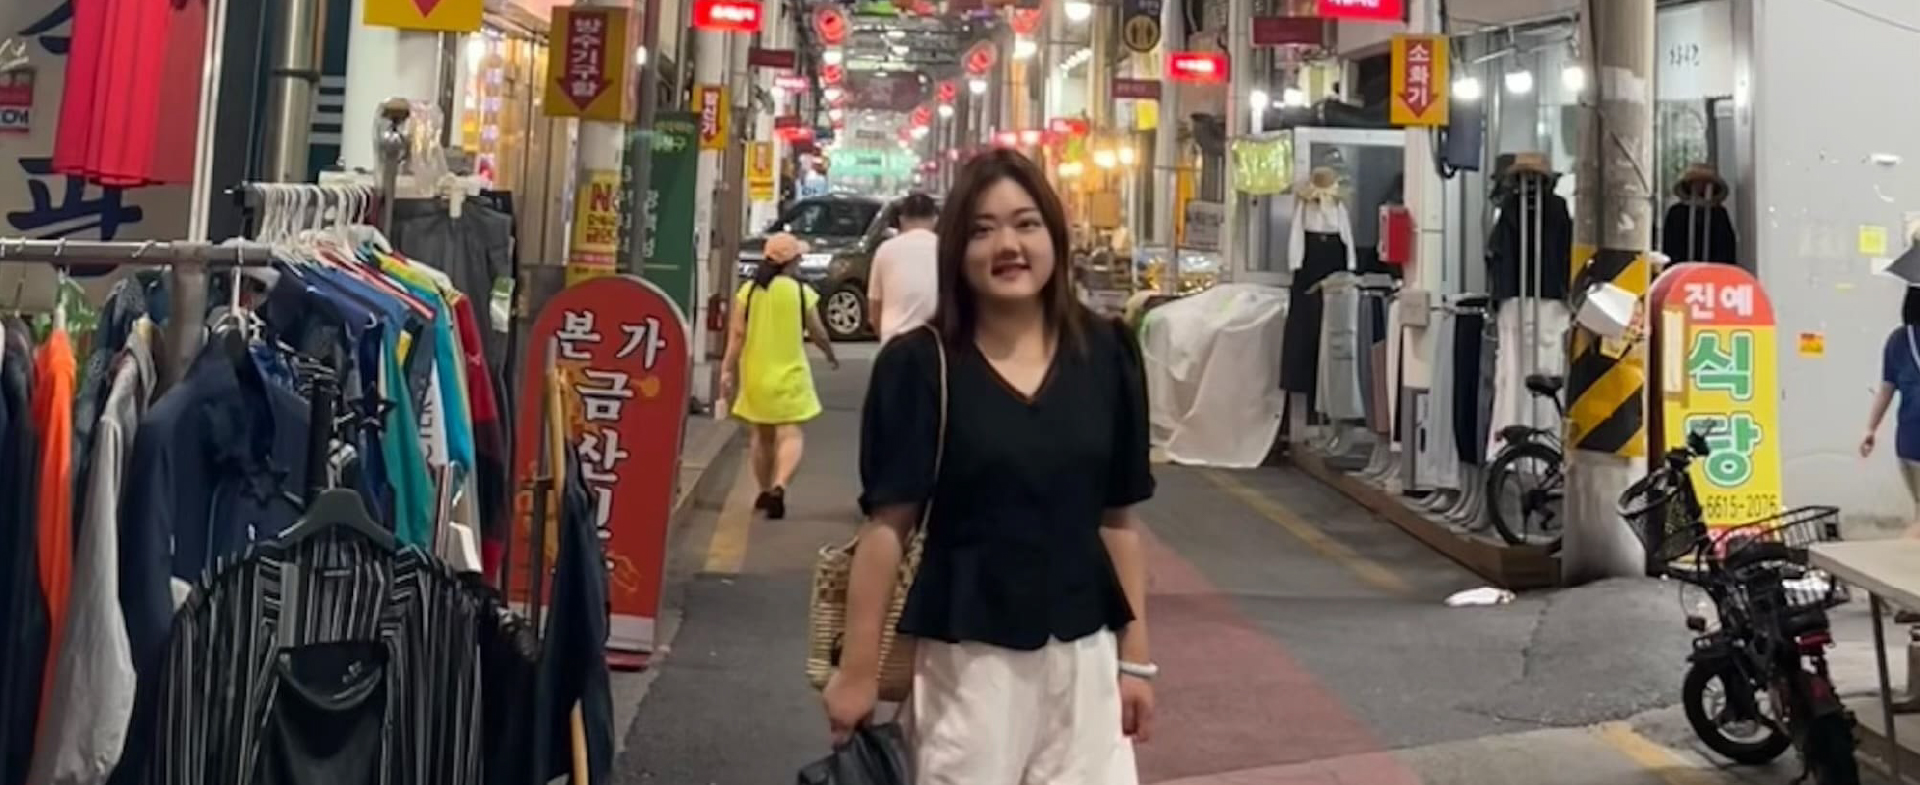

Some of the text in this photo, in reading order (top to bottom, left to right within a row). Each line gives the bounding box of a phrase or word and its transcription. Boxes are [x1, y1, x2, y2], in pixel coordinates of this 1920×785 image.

[1408, 43, 1430, 107] 소화기
[1684, 282, 1753, 319] 진예
[1687, 331, 1762, 487] 식당
